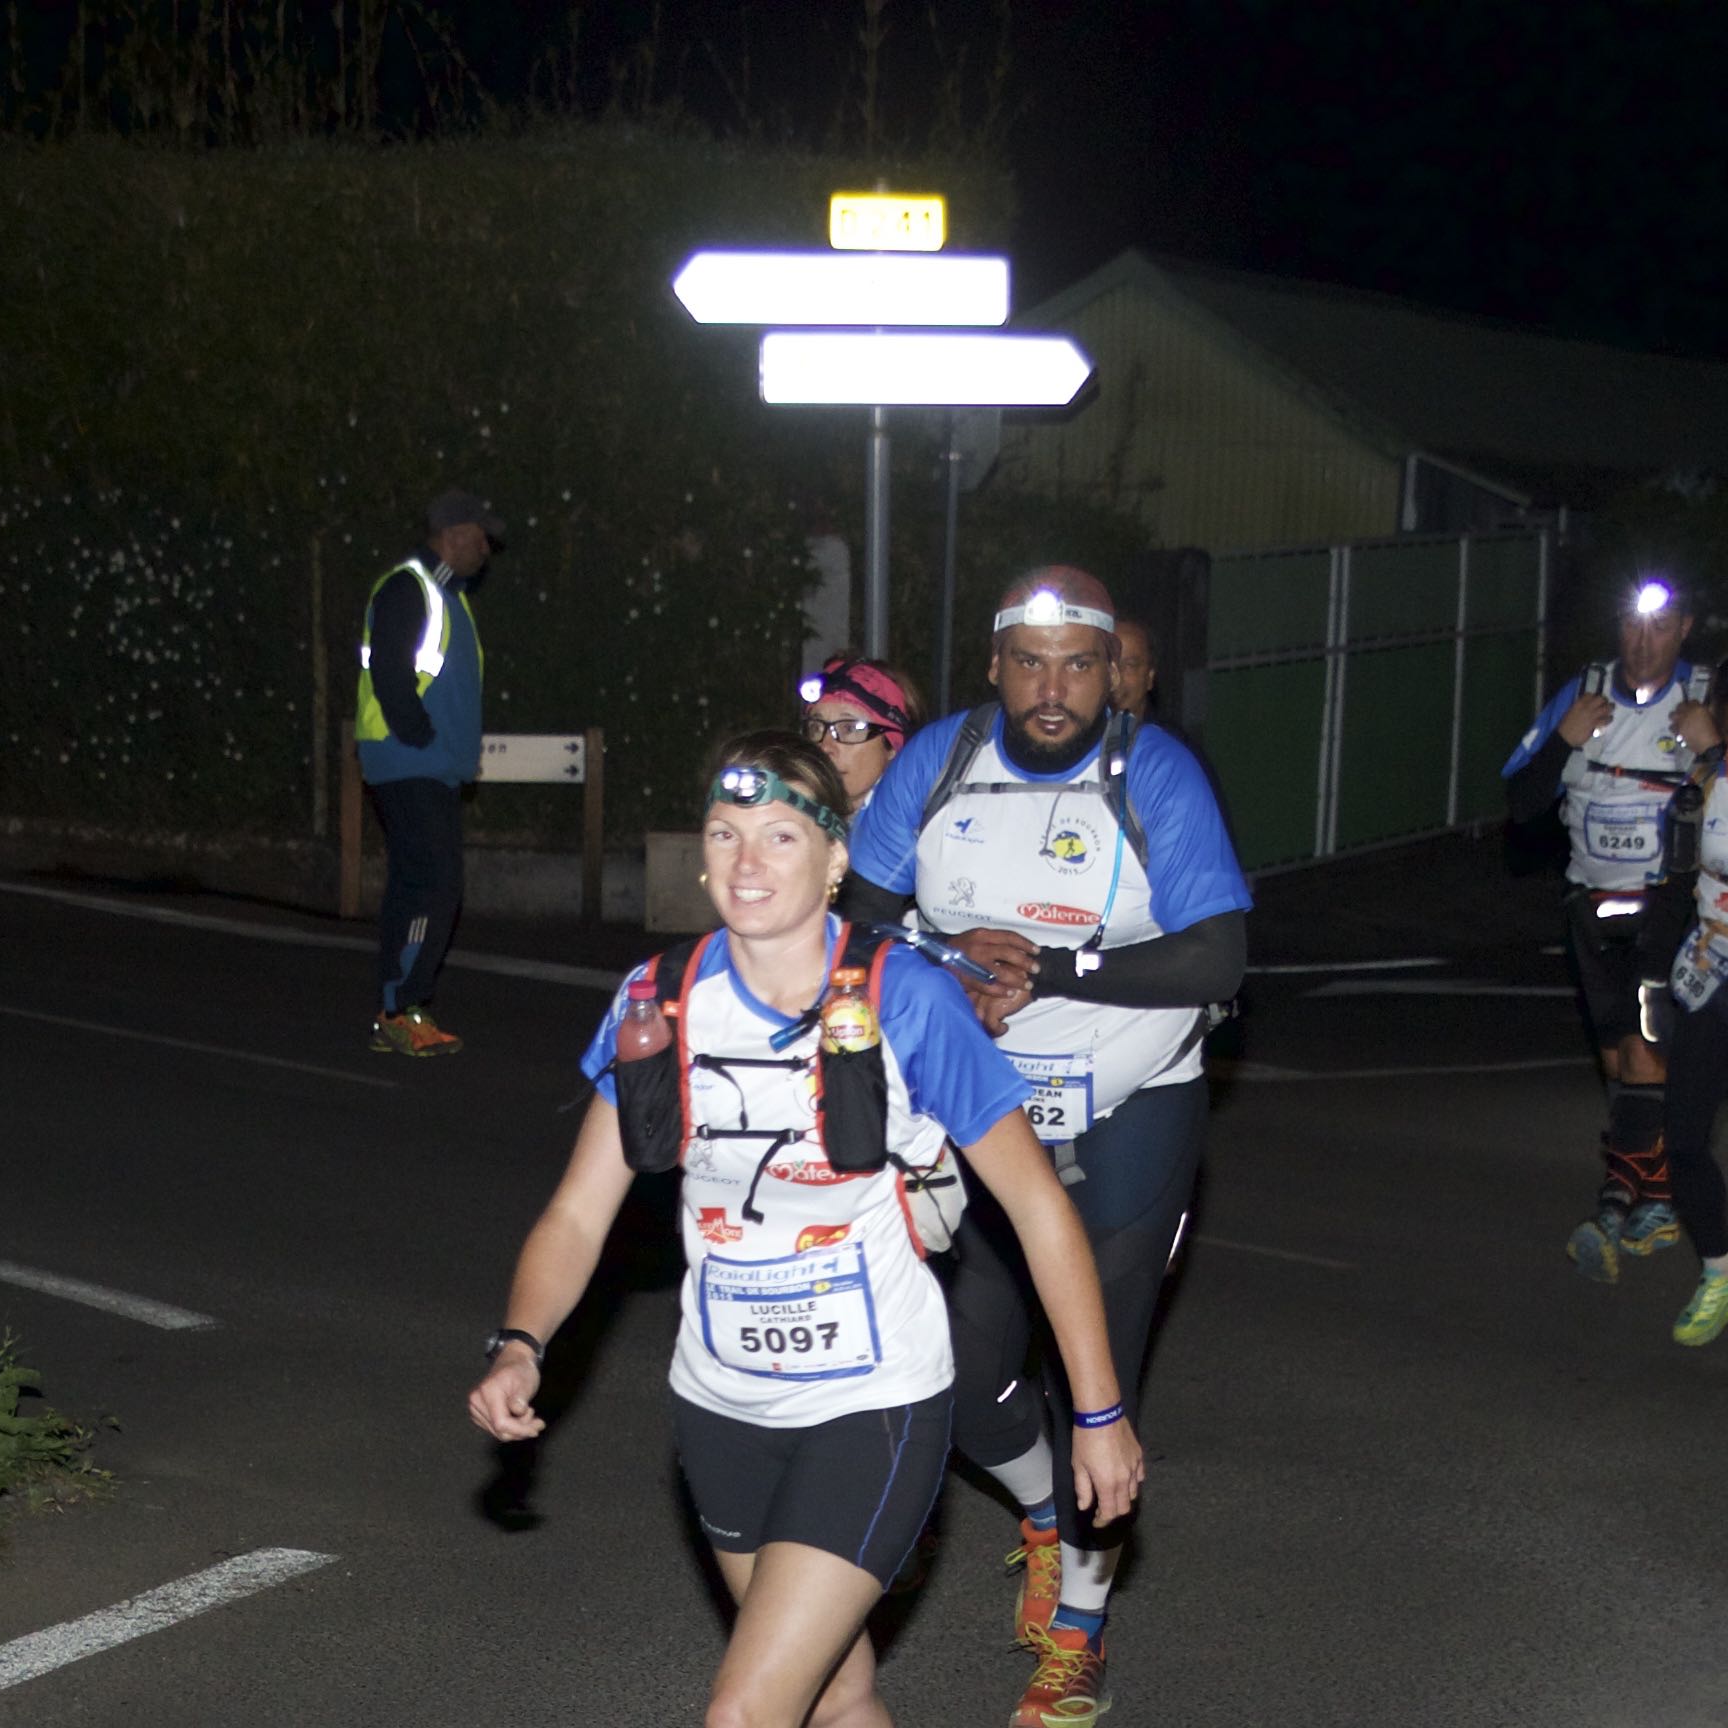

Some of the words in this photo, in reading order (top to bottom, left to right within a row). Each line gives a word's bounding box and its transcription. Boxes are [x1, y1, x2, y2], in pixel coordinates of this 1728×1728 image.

[933, 906, 992, 922] PEUGEOT
[750, 1301, 817, 1316] LUCILLE
[740, 1321, 840, 1354] 5097
